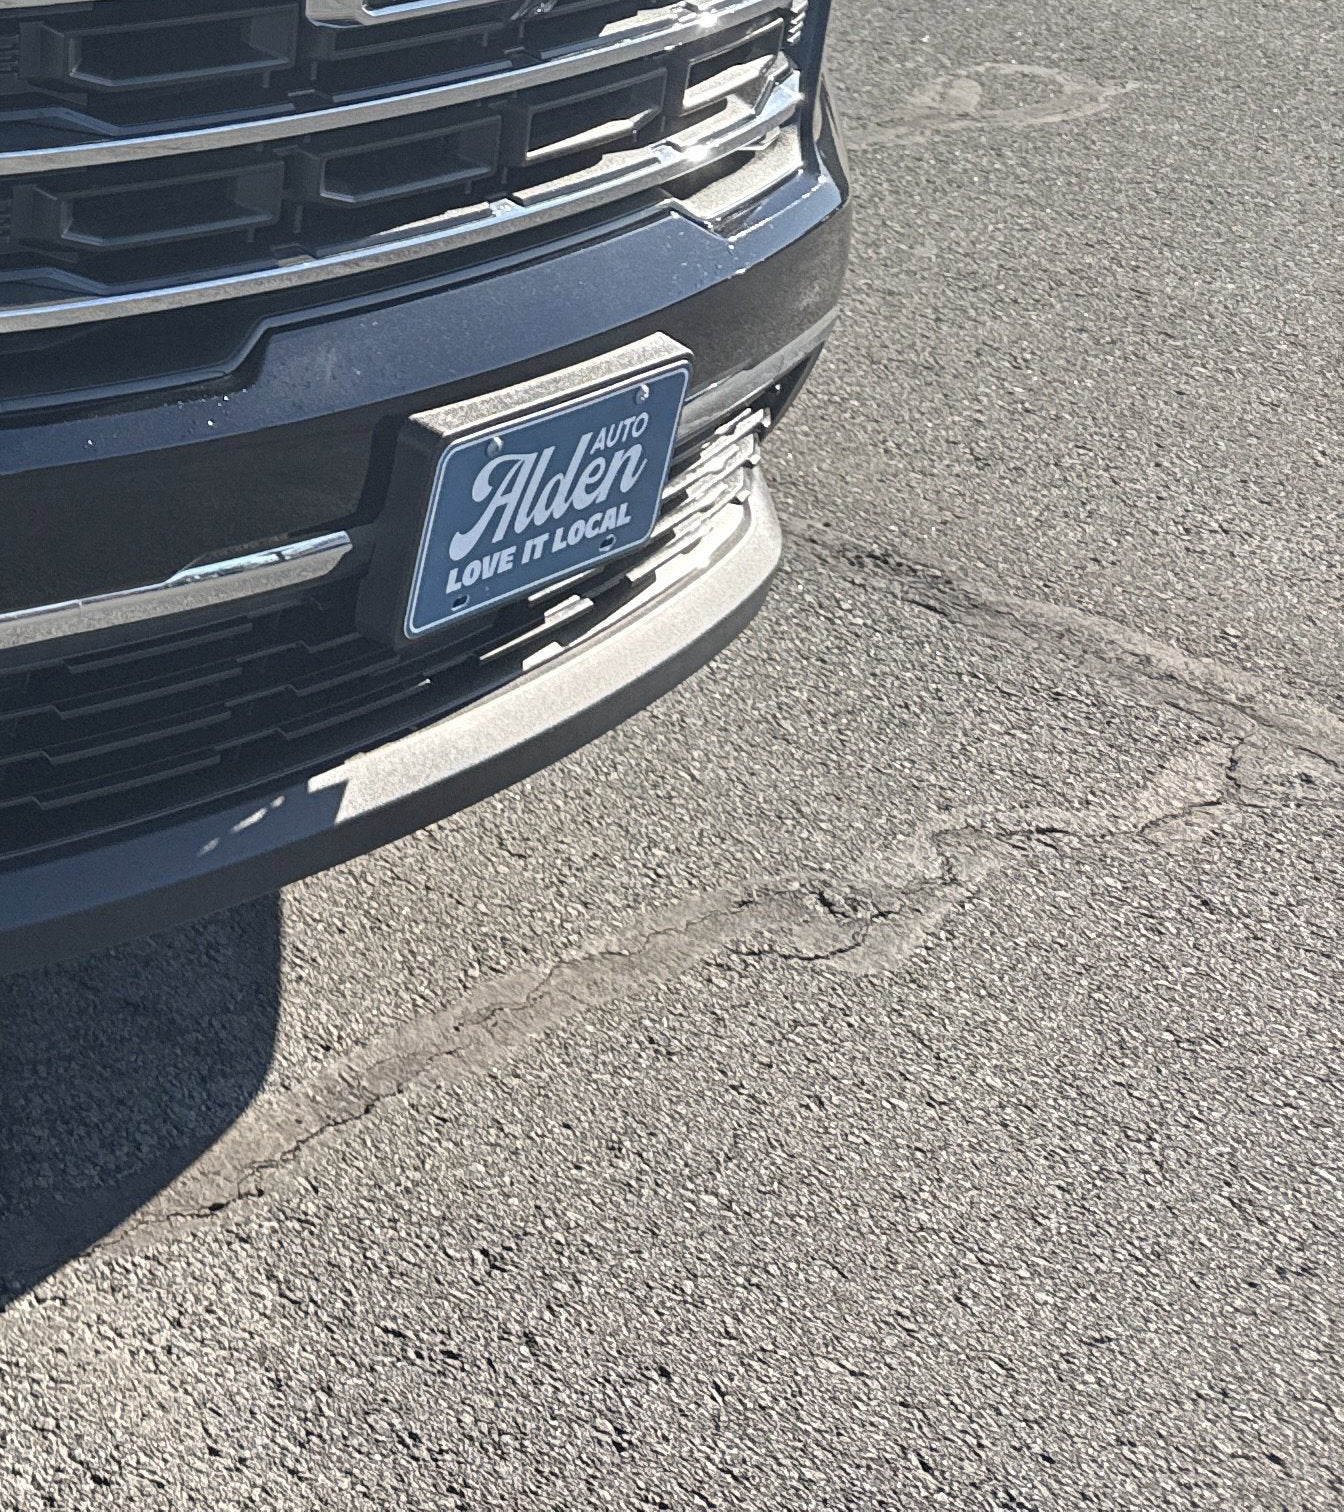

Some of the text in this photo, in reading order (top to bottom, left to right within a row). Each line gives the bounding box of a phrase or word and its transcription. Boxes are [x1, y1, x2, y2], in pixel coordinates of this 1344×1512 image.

[590, 412, 649, 454] AUTO
[448, 433, 647, 561] Alden
[445, 502, 631, 595] LOVE IT LOCAL
